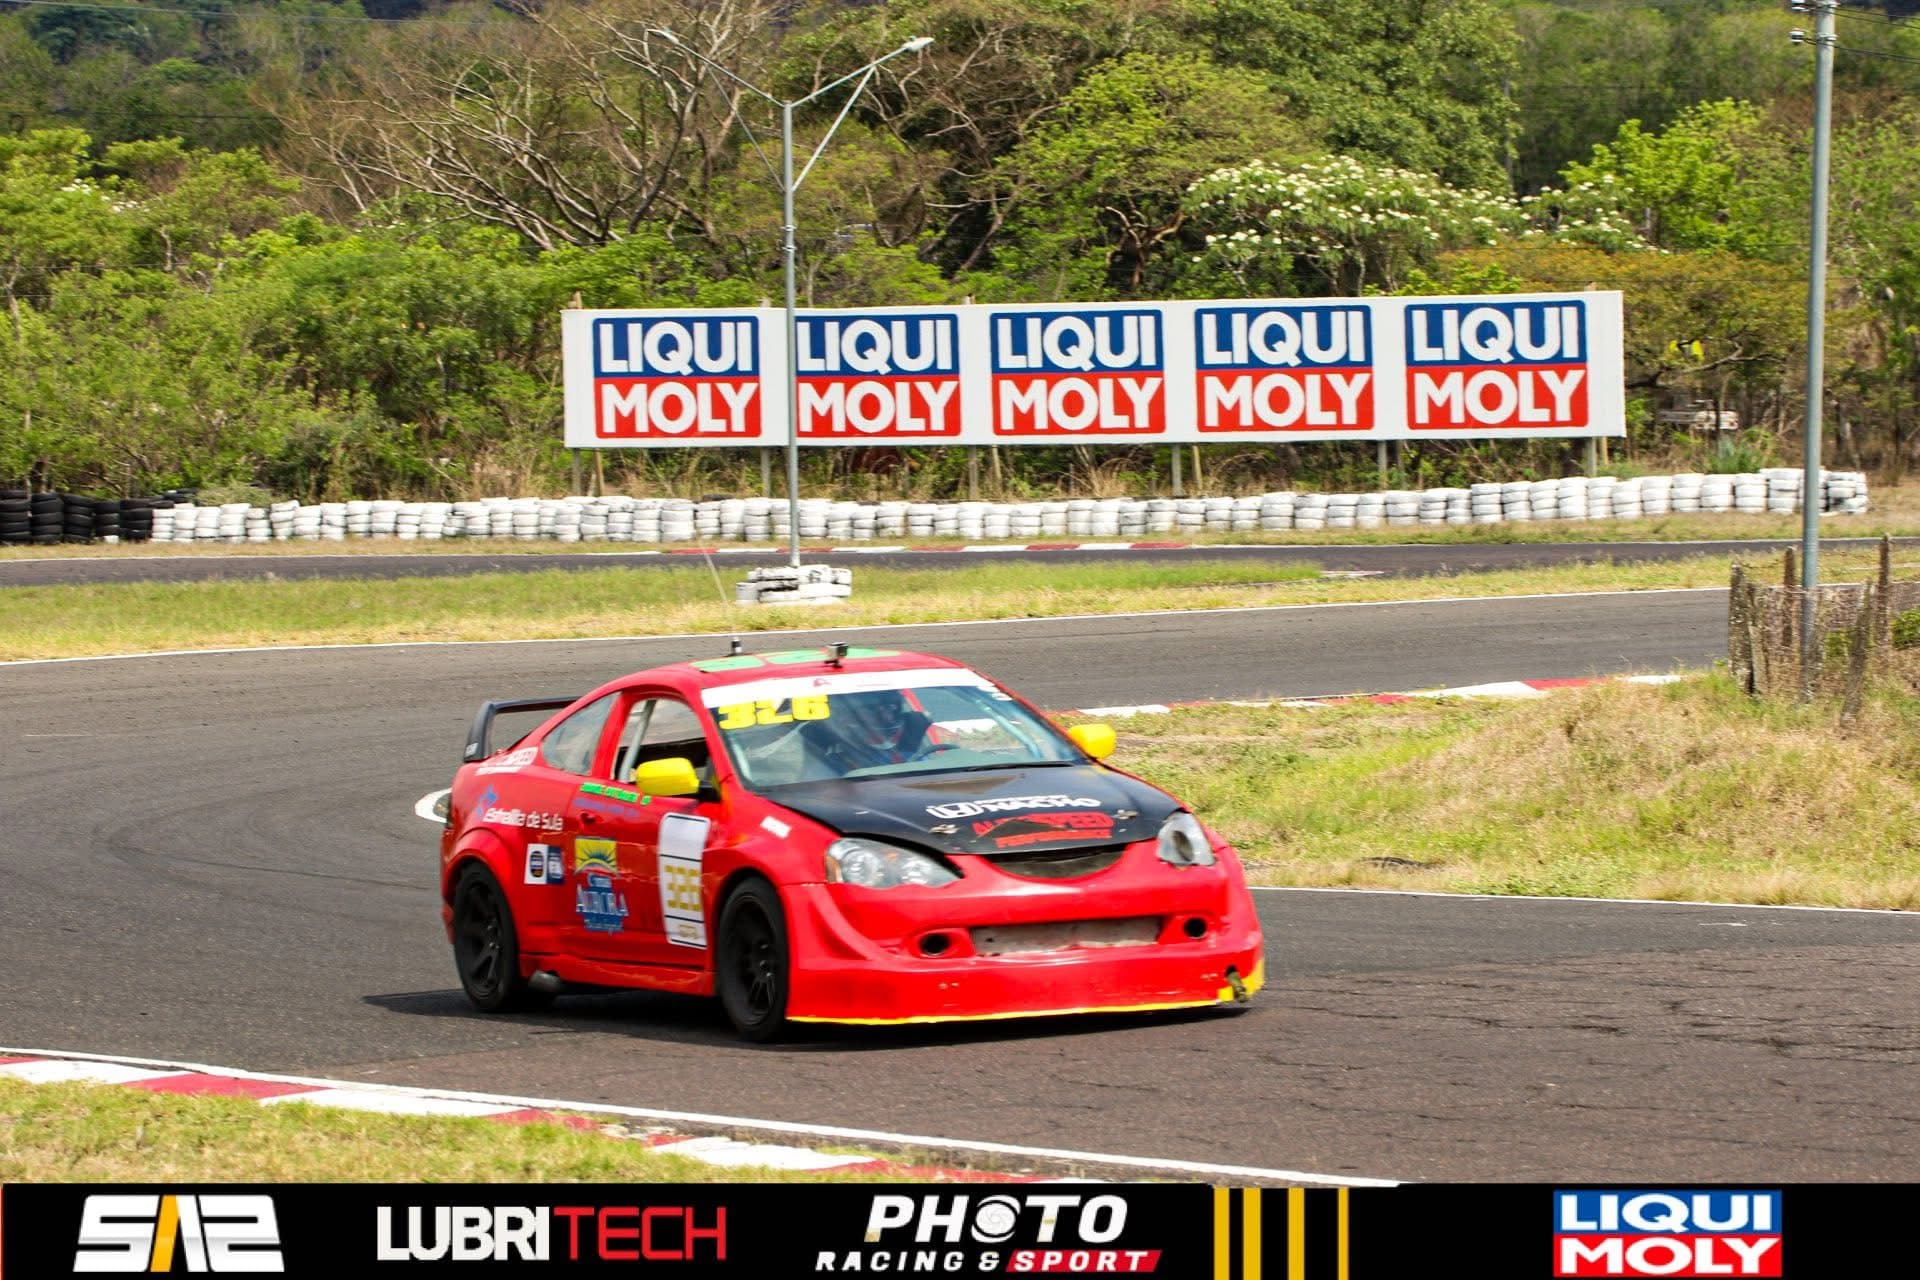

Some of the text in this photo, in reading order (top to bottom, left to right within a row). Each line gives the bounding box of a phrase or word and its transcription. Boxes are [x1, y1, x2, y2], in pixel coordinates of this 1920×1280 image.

[600, 319, 753, 376] LIQUI
[796, 318, 953, 376] LIQUI
[997, 314, 1157, 374] LIQUI
[1202, 310, 1366, 367] LIQUI
[1411, 306, 1579, 365] LIQUI
[601, 381, 759, 434] MOLY
[798, 379, 959, 433] MOLY
[999, 376, 1163, 431] MOLY
[1204, 372, 1372, 427] MOLY
[1413, 369, 1586, 426] MOLY
[526, 811, 541, 829] de
